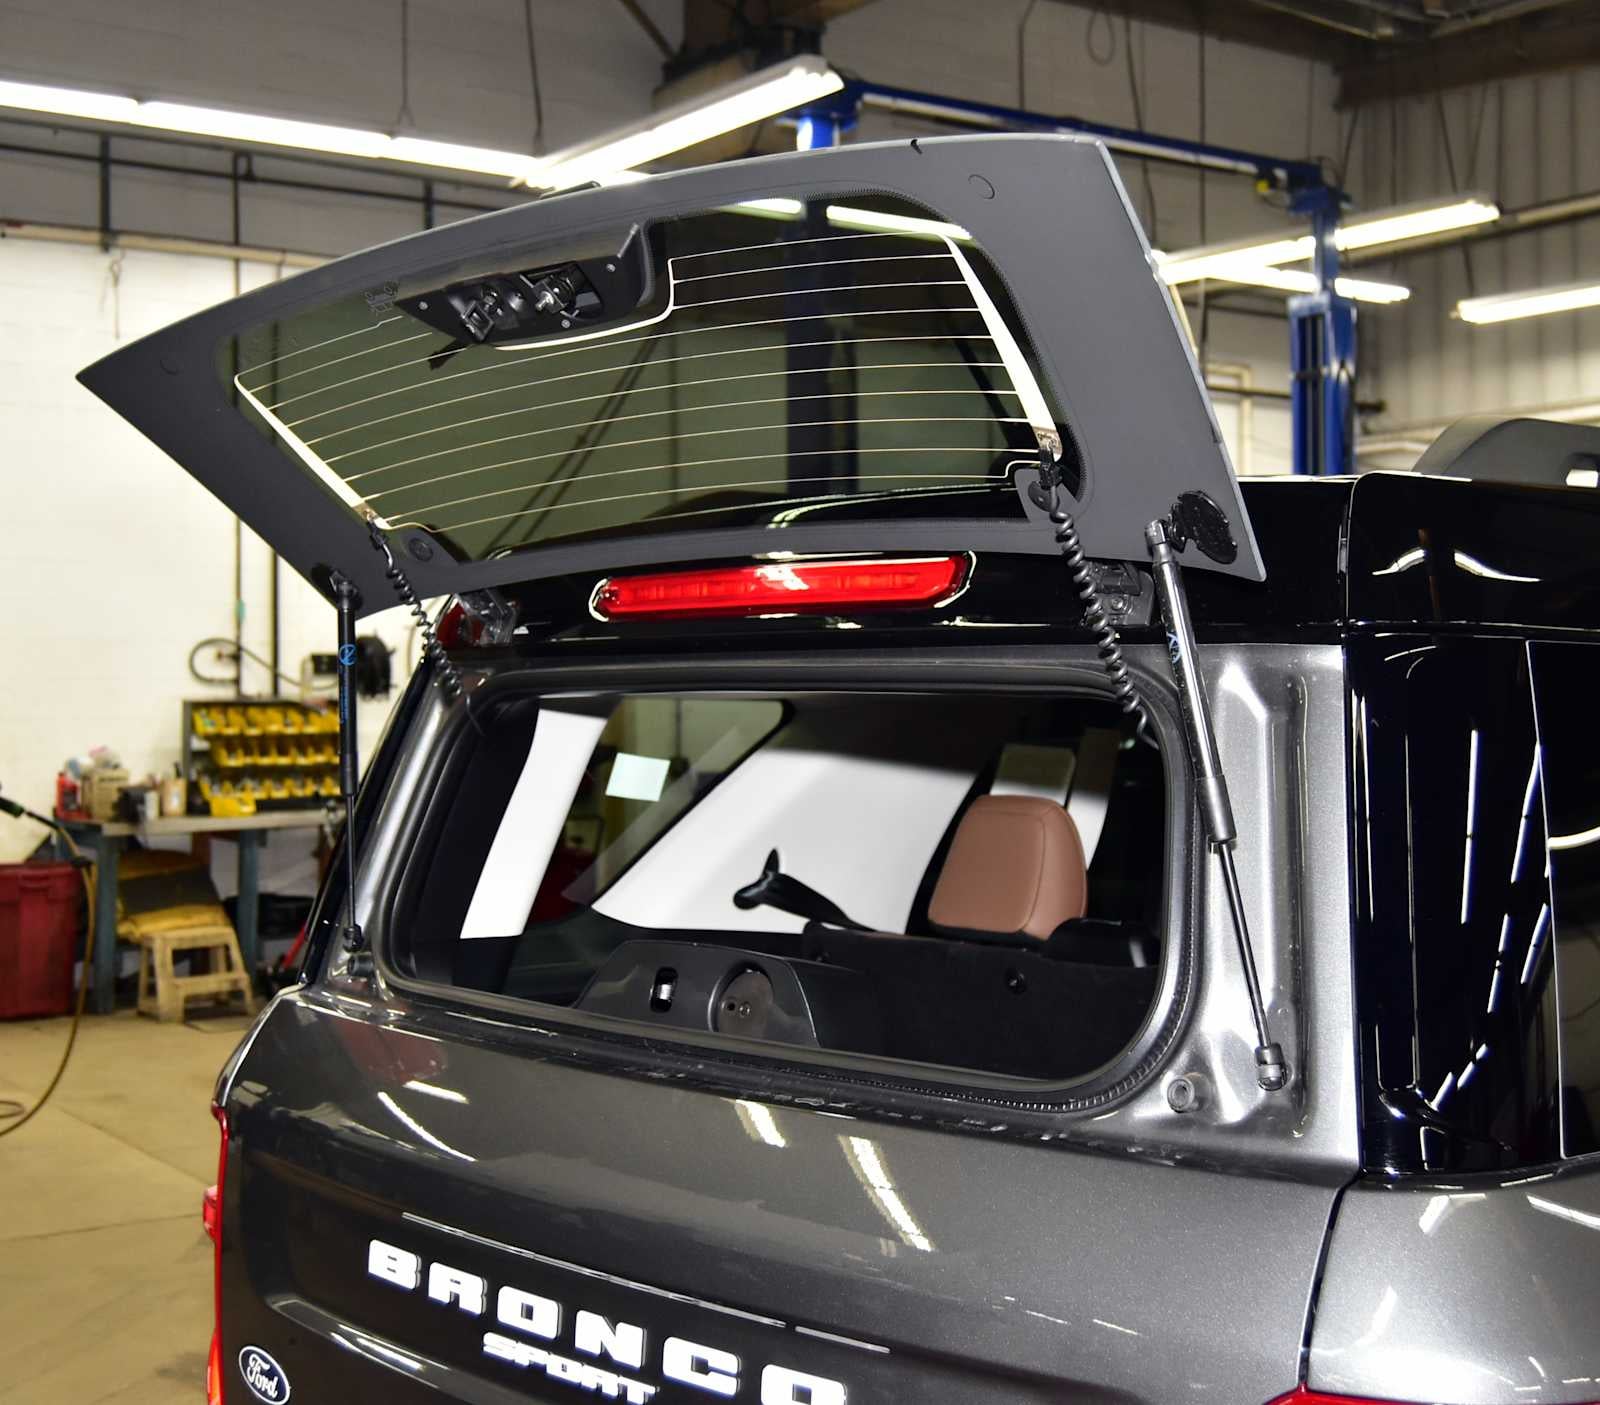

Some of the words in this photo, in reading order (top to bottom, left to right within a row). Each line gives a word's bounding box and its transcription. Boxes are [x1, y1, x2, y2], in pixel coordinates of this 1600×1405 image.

[367, 1239, 847, 1405] BRONCO
[245, 1352, 280, 1399] Ford
[482, 1331, 660, 1405] SPORT
